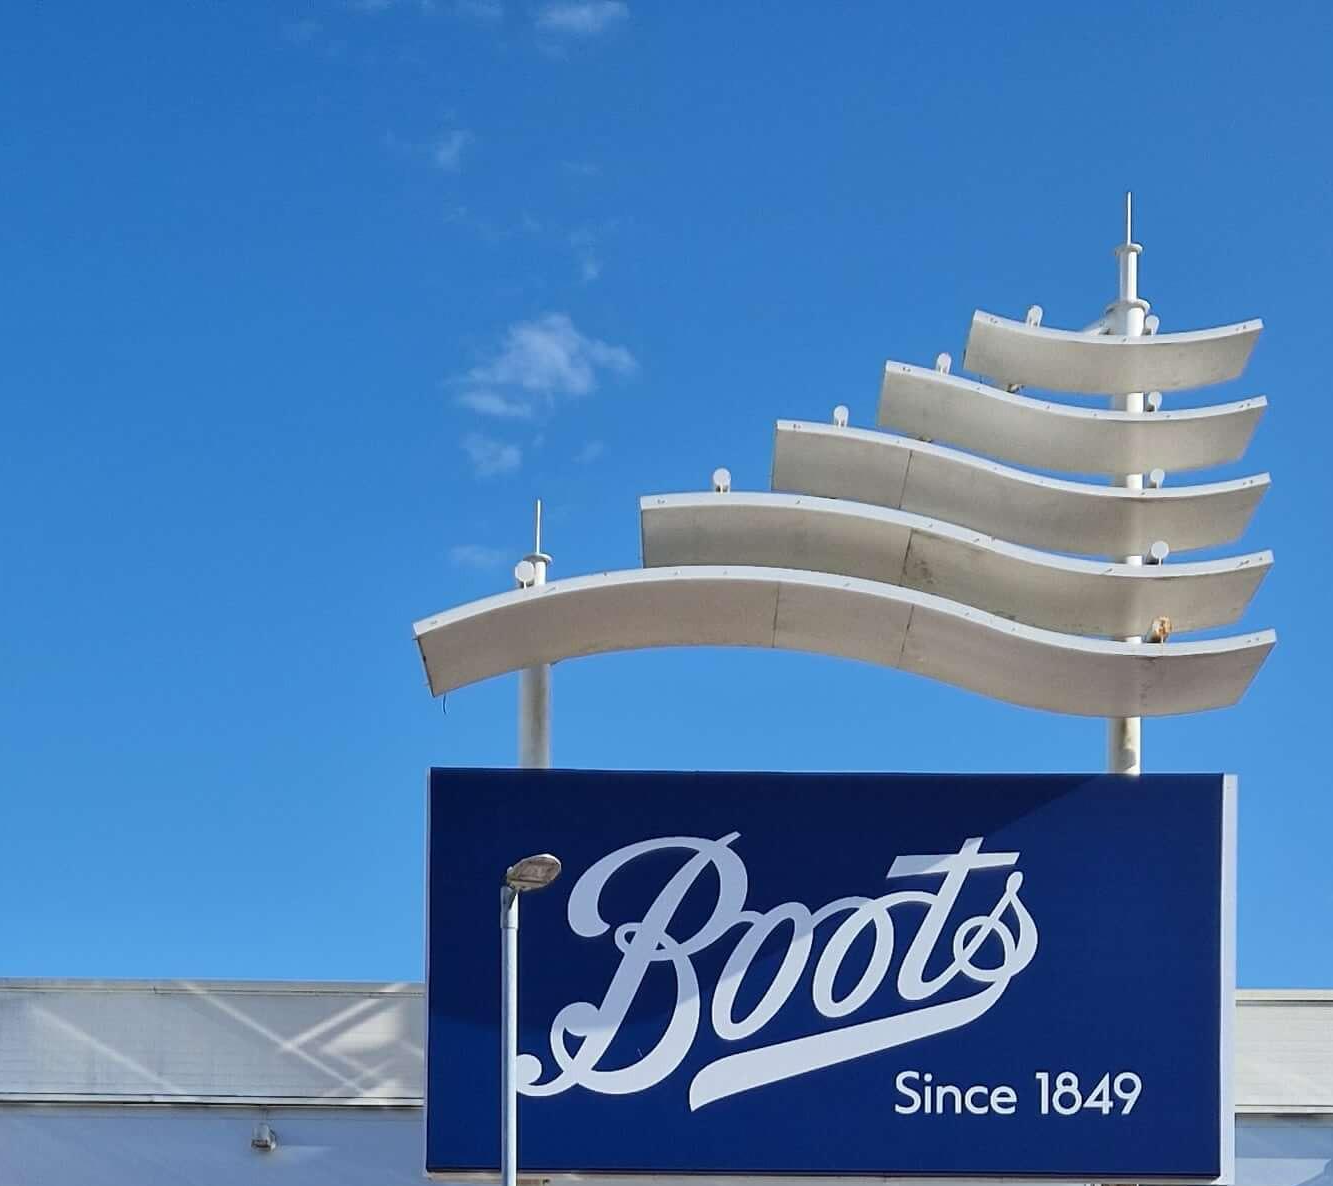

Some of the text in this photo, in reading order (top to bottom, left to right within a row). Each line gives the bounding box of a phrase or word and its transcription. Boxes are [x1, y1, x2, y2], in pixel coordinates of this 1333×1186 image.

[516, 831, 1039, 1111] Boots
[894, 1071, 1143, 1115] Since 1849
